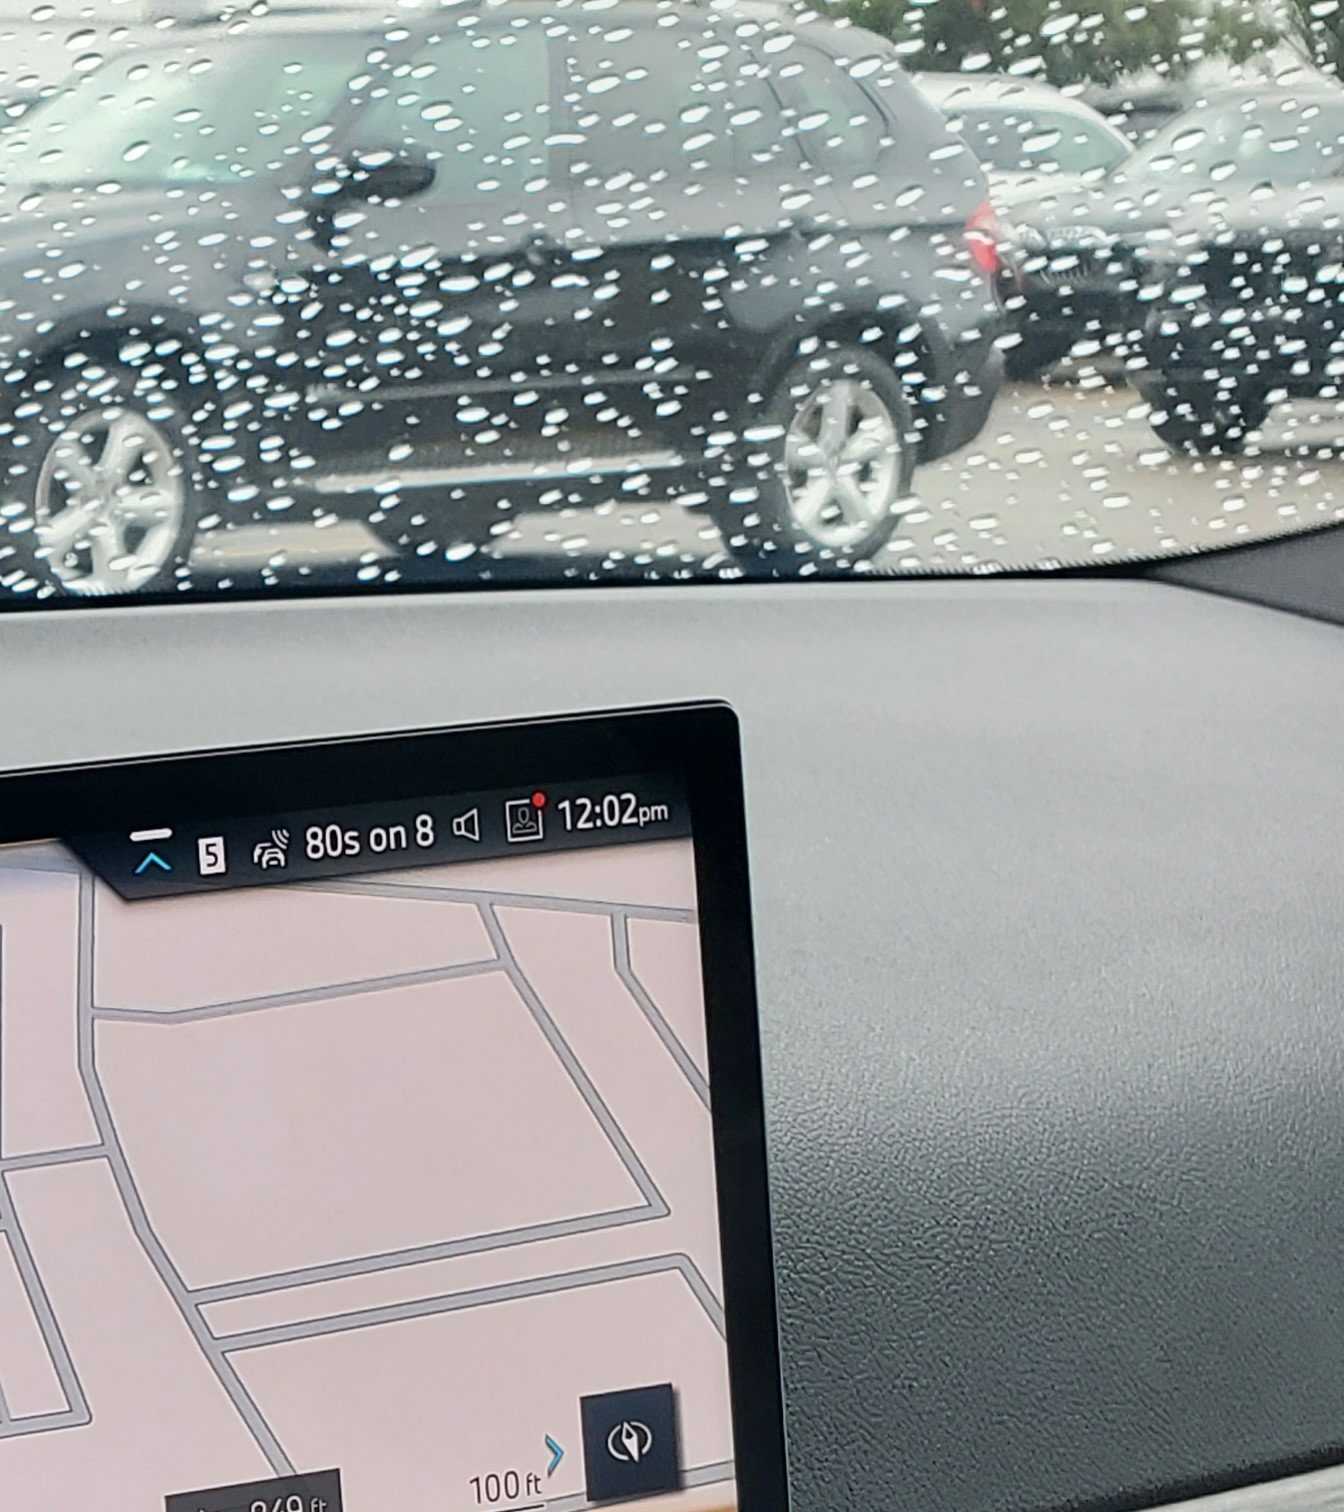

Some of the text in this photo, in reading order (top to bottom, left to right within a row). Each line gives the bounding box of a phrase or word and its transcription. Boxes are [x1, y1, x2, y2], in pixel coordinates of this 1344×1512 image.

[557, 793, 669, 831] 12:02pm
[306, 815, 435, 859] 80s on 8
[469, 1470, 544, 1504] 100 ft
